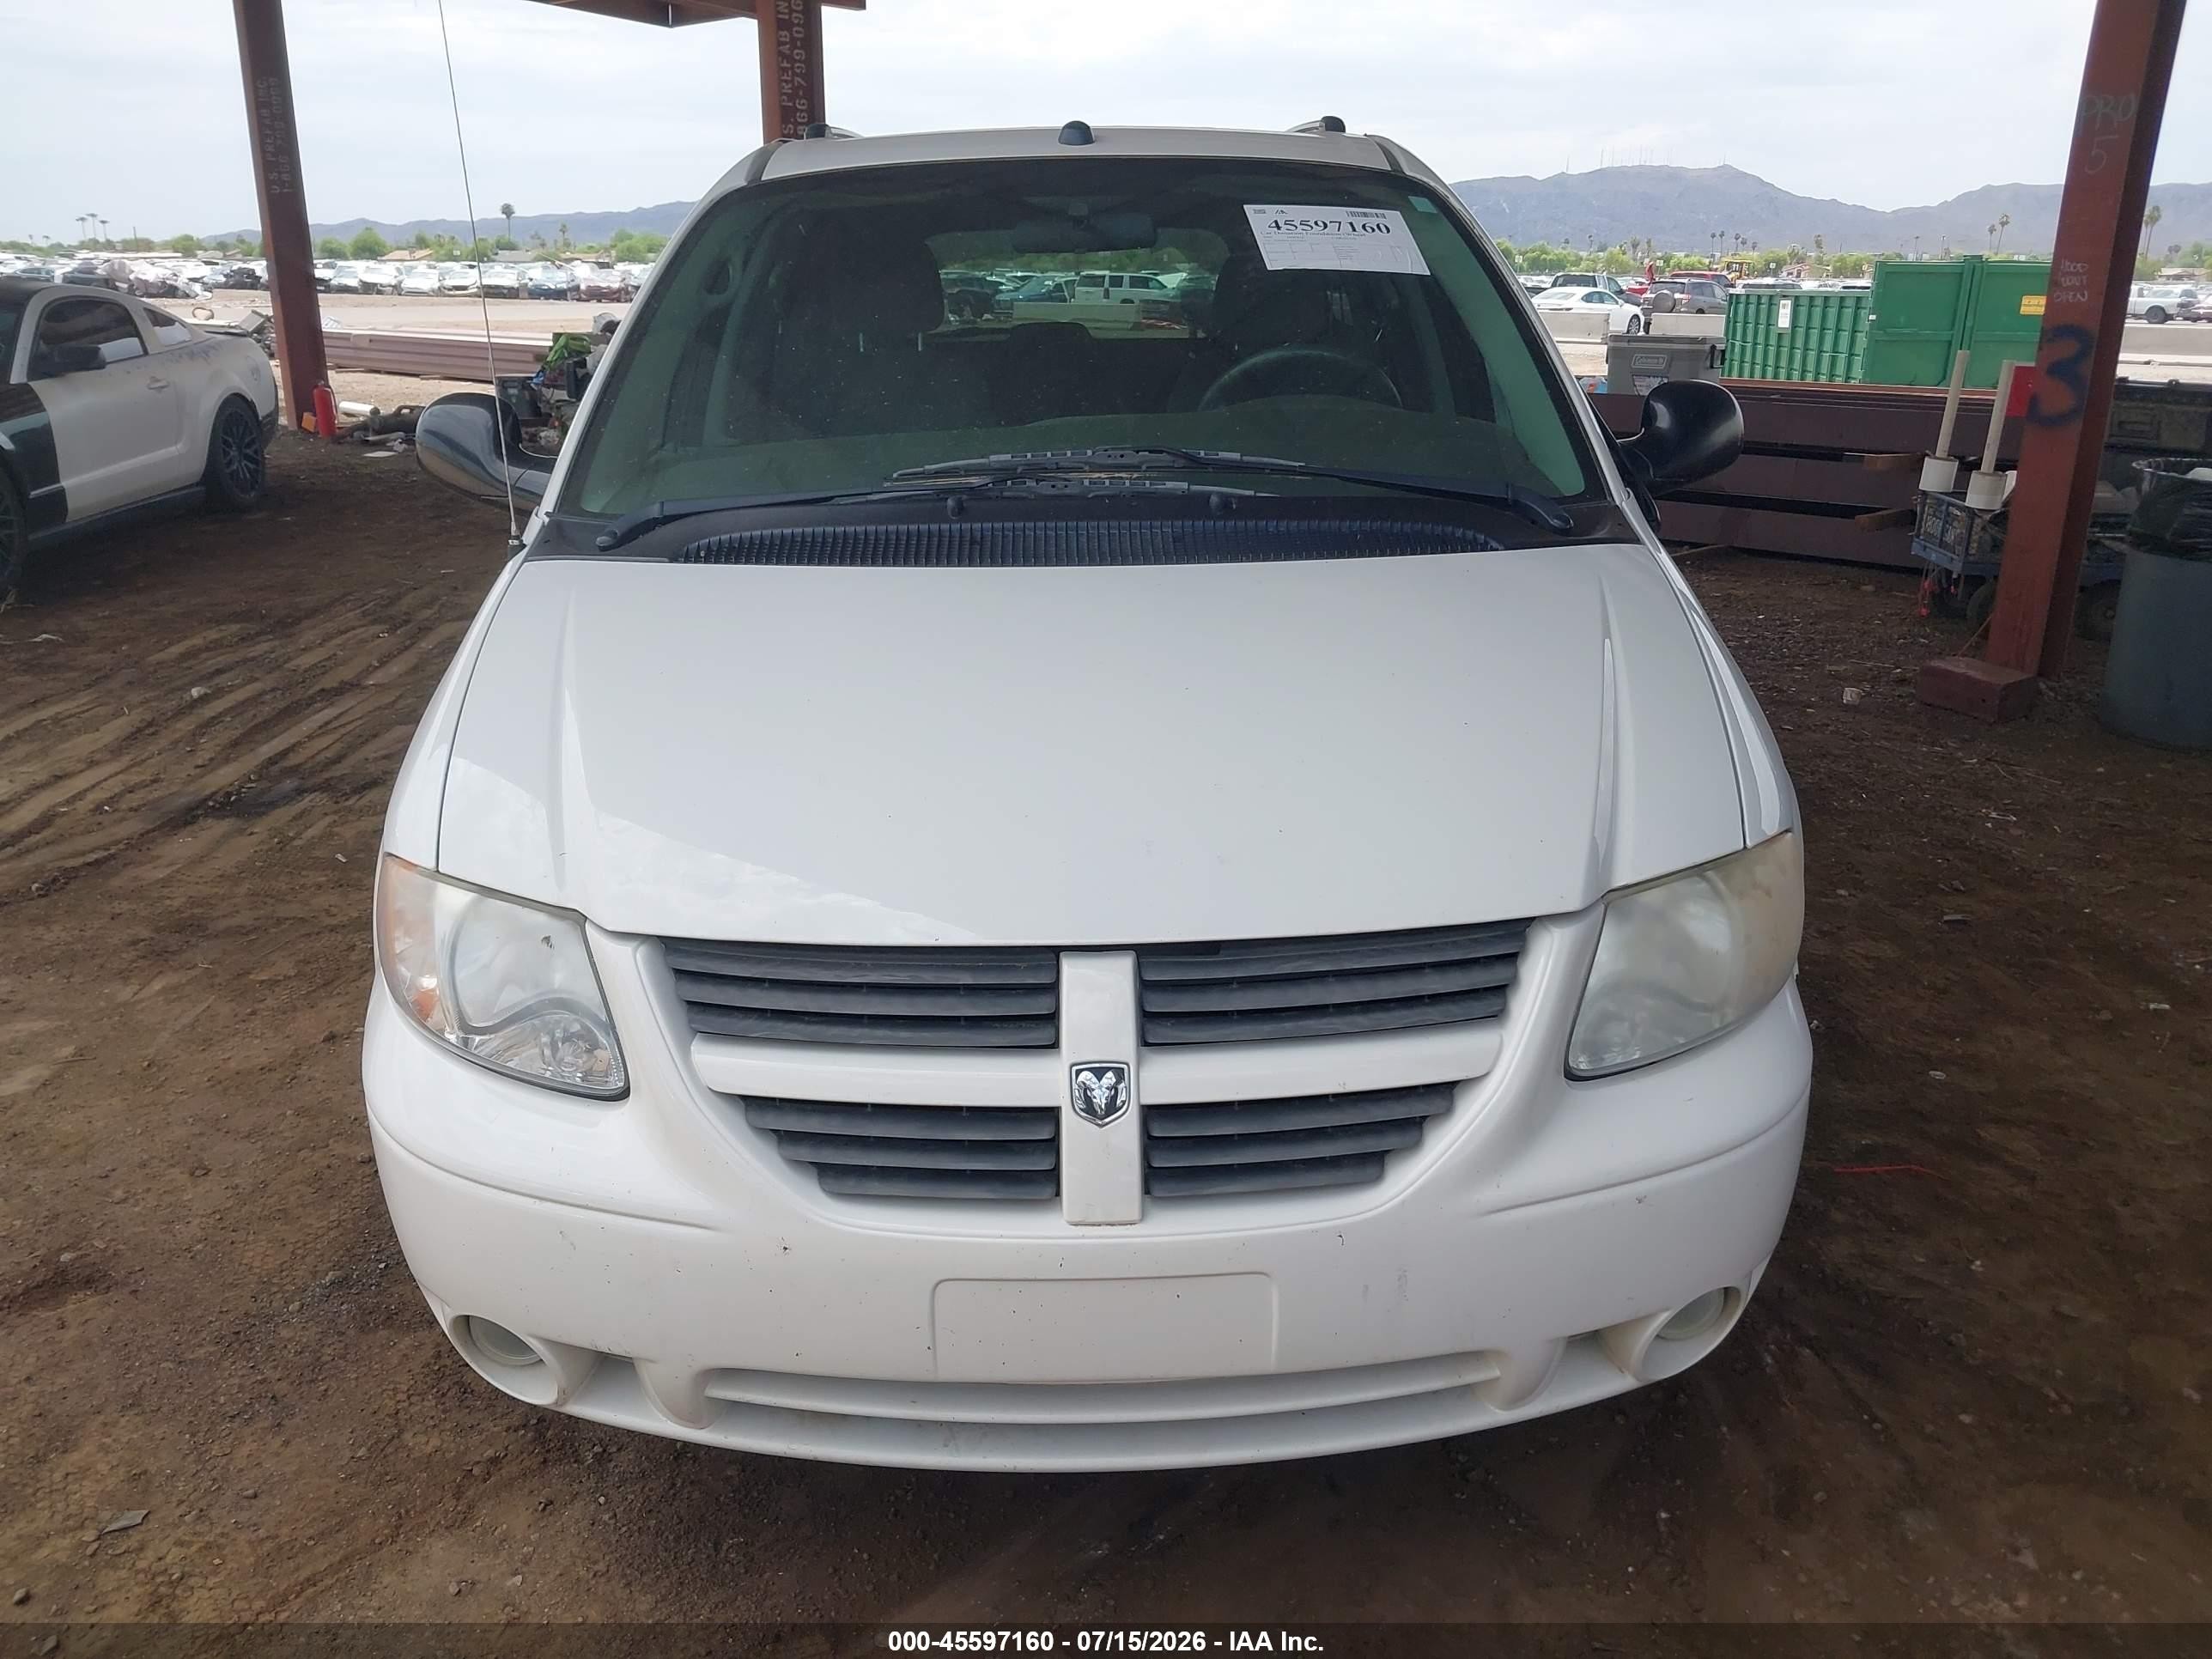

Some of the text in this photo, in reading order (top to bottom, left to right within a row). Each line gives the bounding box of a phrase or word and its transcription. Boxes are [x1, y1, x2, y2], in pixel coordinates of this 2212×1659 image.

[778, 29, 793, 106] PREFAB
[1267, 219, 1391, 234] 45597160
[2027, 325, 2092, 427] 3
